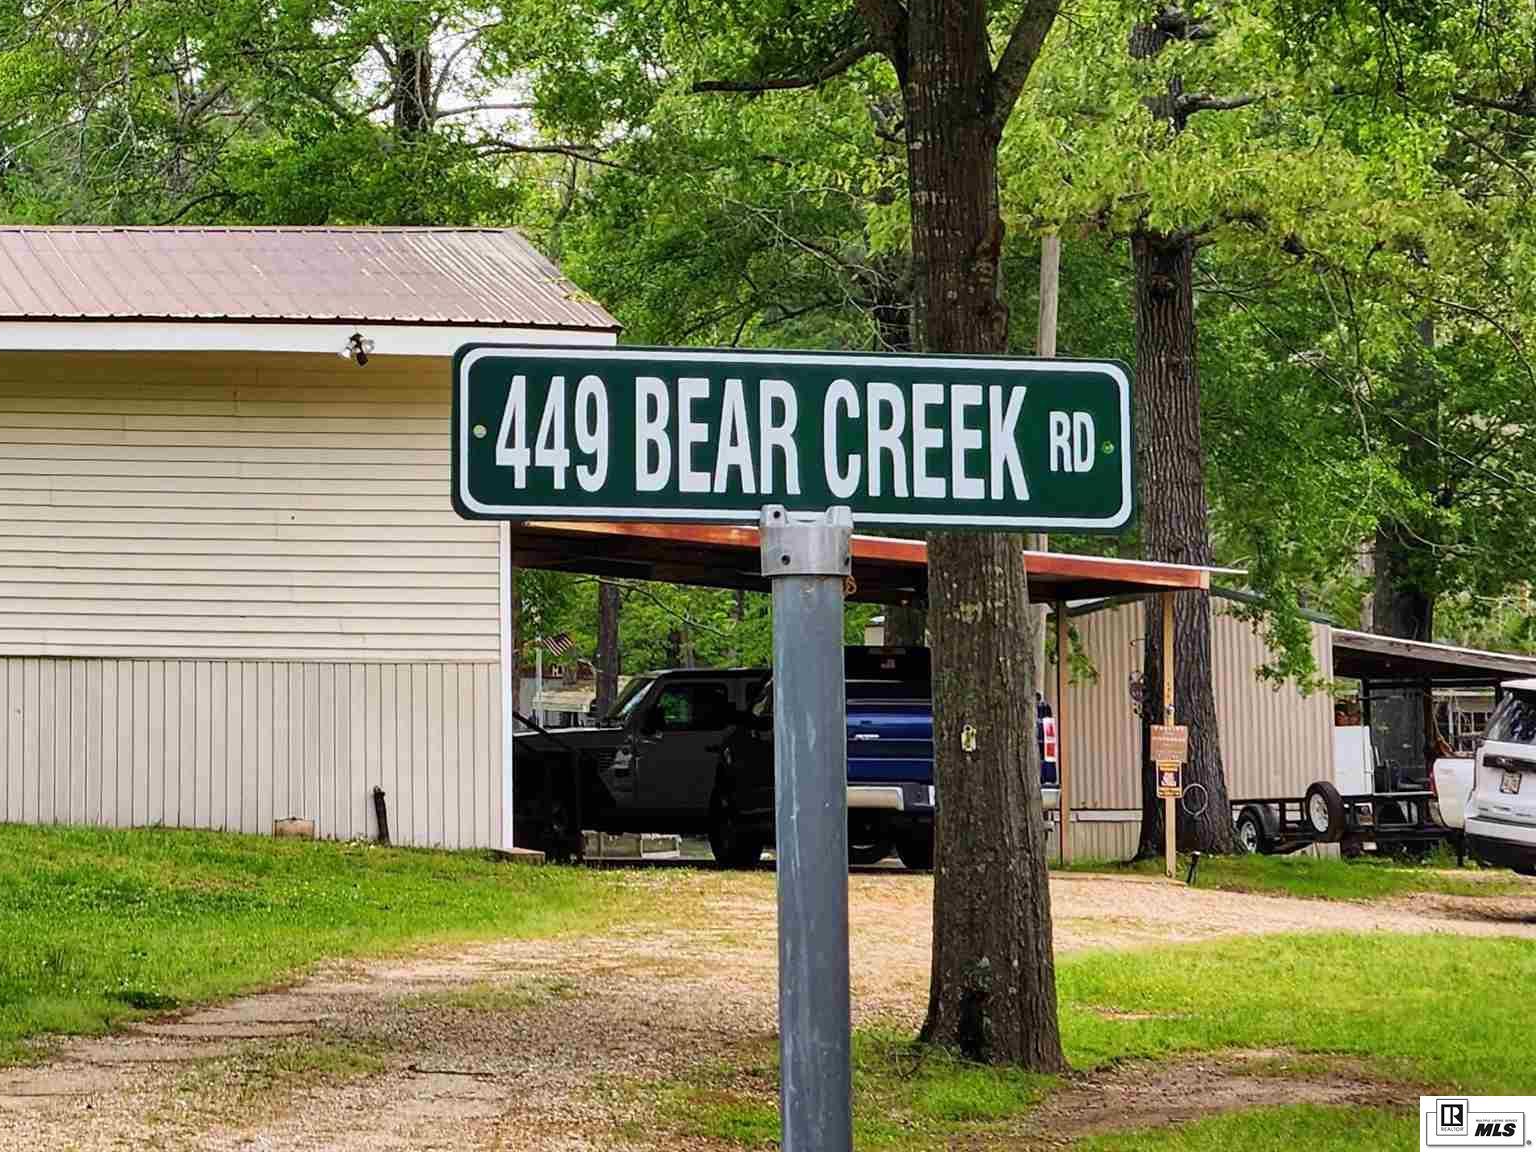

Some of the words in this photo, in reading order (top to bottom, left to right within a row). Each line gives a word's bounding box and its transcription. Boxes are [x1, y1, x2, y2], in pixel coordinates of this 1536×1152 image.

[495, 375, 609, 493] 449
[635, 376, 801, 495] BEAR
[823, 378, 1030, 501] CREEK
[1049, 411, 1095, 473] RD
